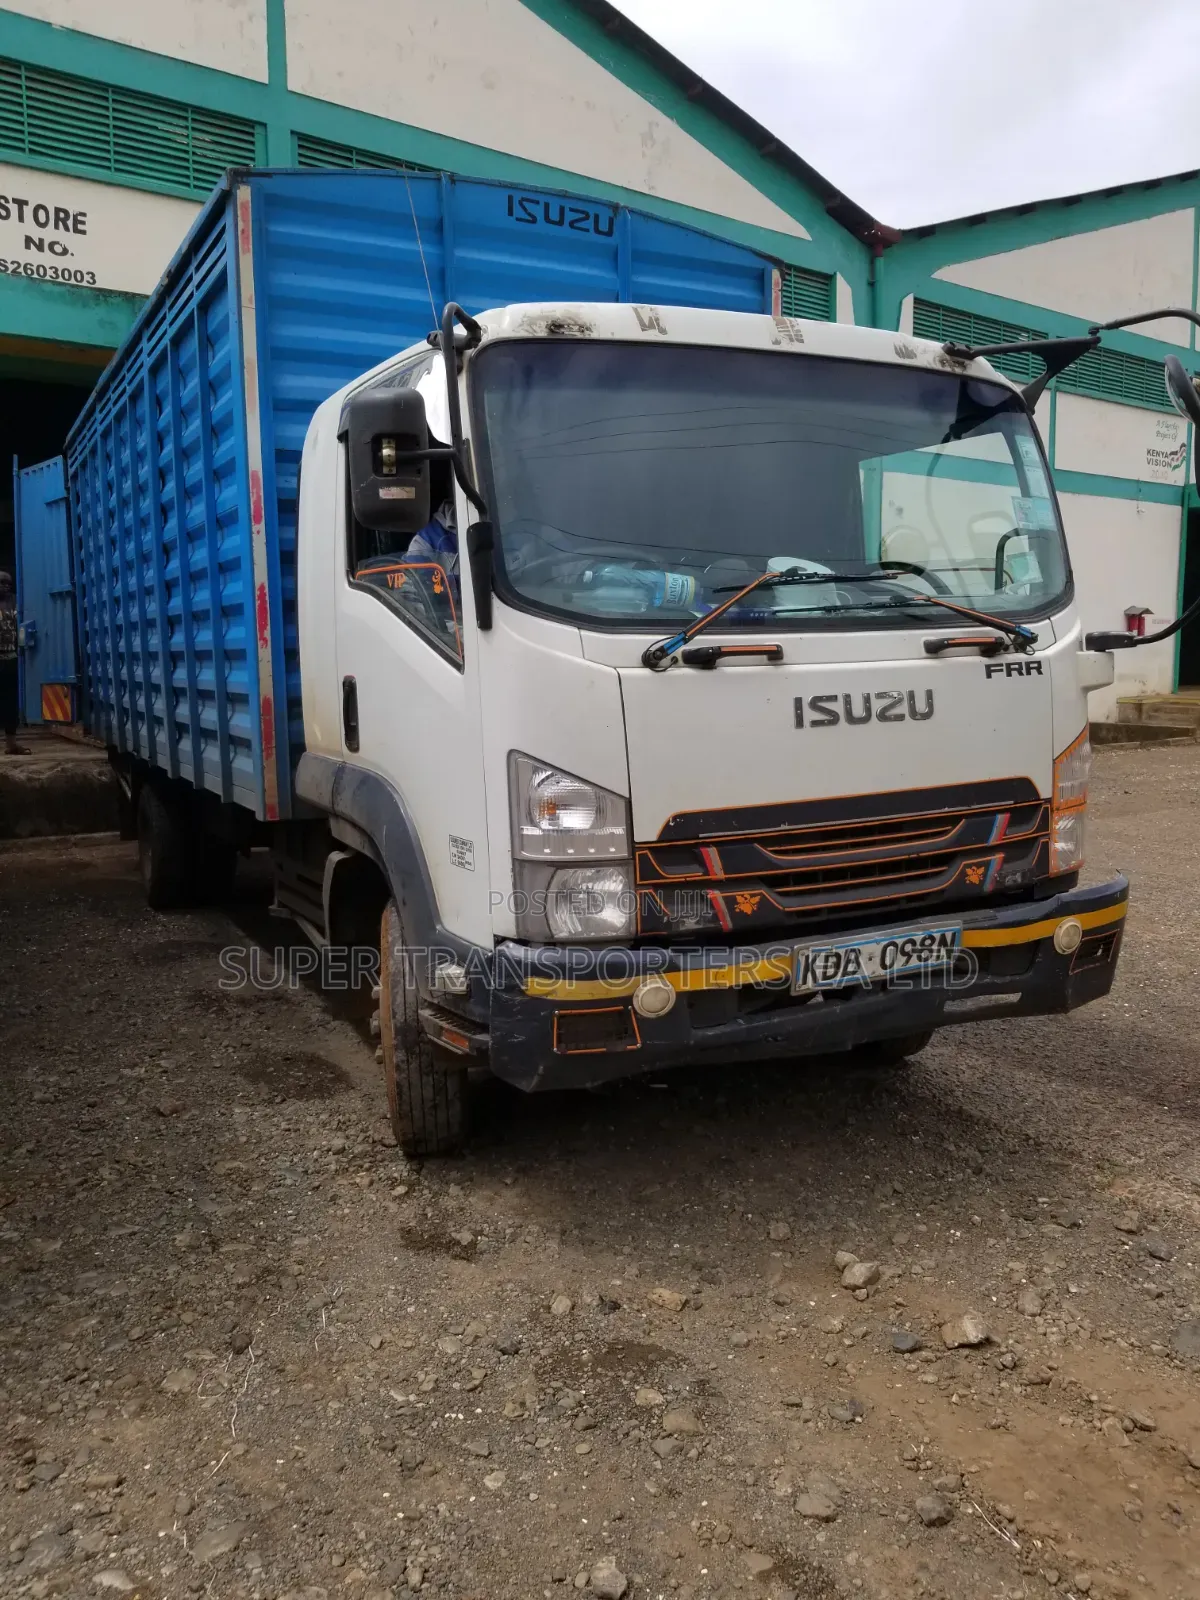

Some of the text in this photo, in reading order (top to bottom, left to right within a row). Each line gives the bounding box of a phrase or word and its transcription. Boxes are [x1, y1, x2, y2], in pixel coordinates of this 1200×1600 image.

[0, 194, 88, 236] STORE
[506, 193, 615, 238] ISUZU
[24, 234, 75, 257] NO.
[1147, 449, 1169, 459] KENYA
[1147, 458, 1172, 468] VISION
[984, 660, 1044, 680] FRR
[793, 688, 935, 730] ISUZU
[879, 931, 957, 971] 098N
